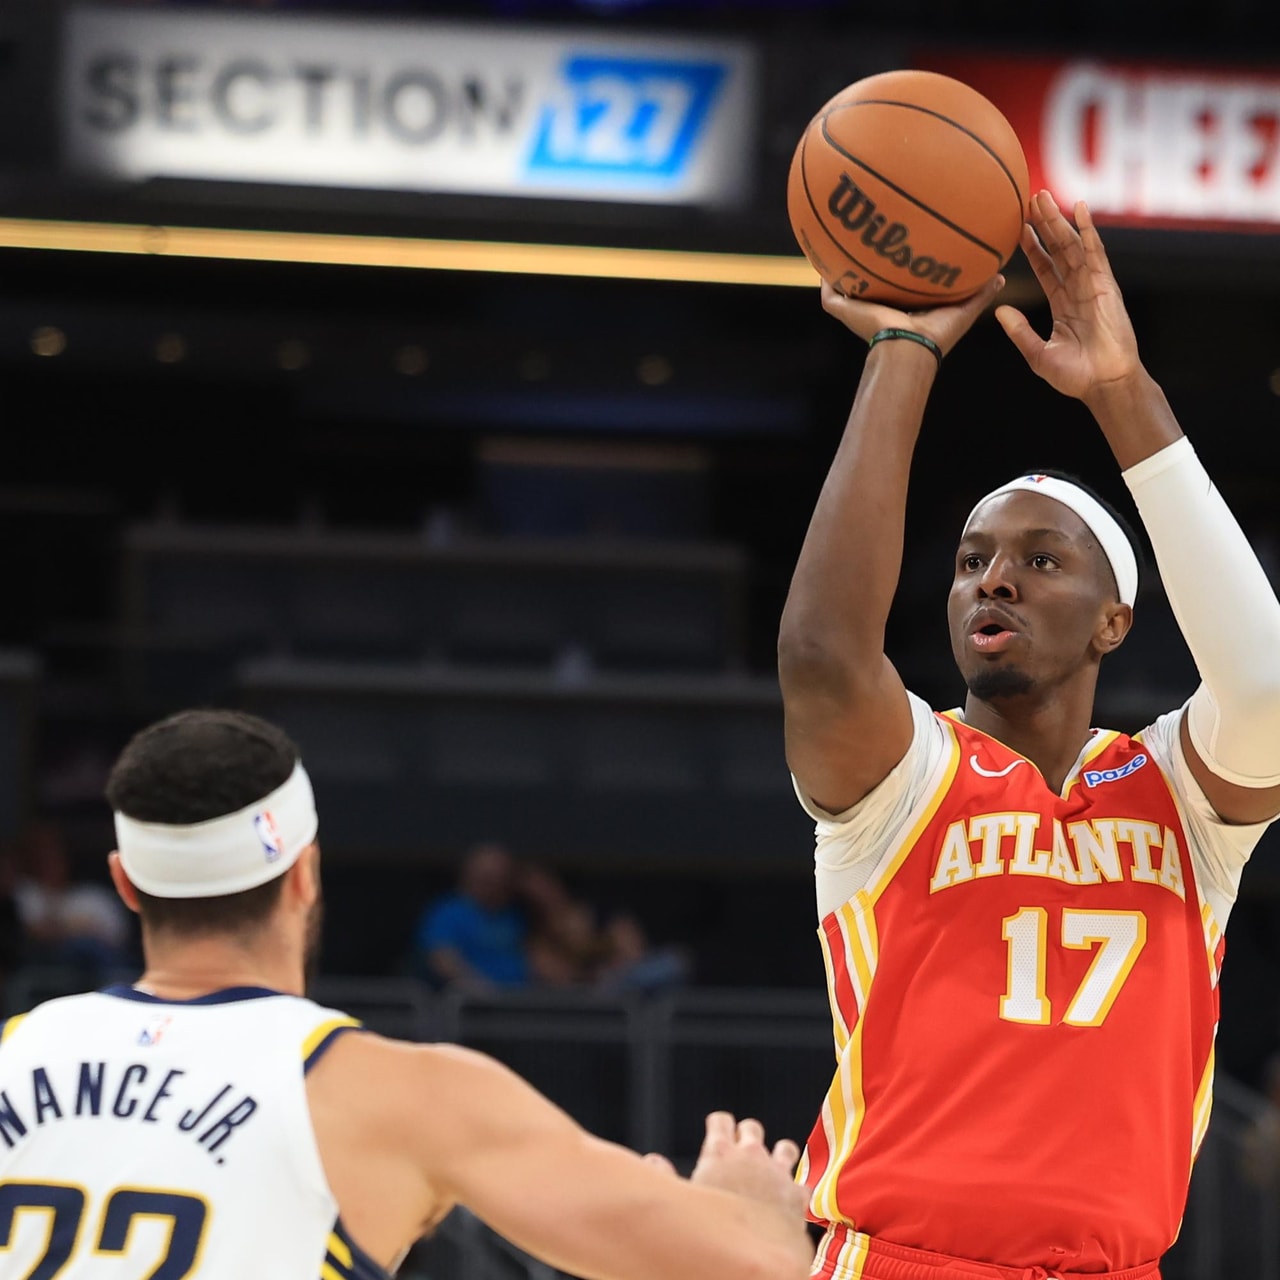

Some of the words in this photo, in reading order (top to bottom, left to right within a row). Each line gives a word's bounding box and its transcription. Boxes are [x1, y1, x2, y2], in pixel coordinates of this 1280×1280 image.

[83, 54, 523, 146] SECTION
[538, 76, 693, 163] 127
[828, 171, 962, 288] Wilson
[1085, 755, 1146, 786] paze
[929, 811, 1186, 903] ATLANTA
[998, 906, 1148, 1027] 17
[177, 1083, 258, 1165] JR.
